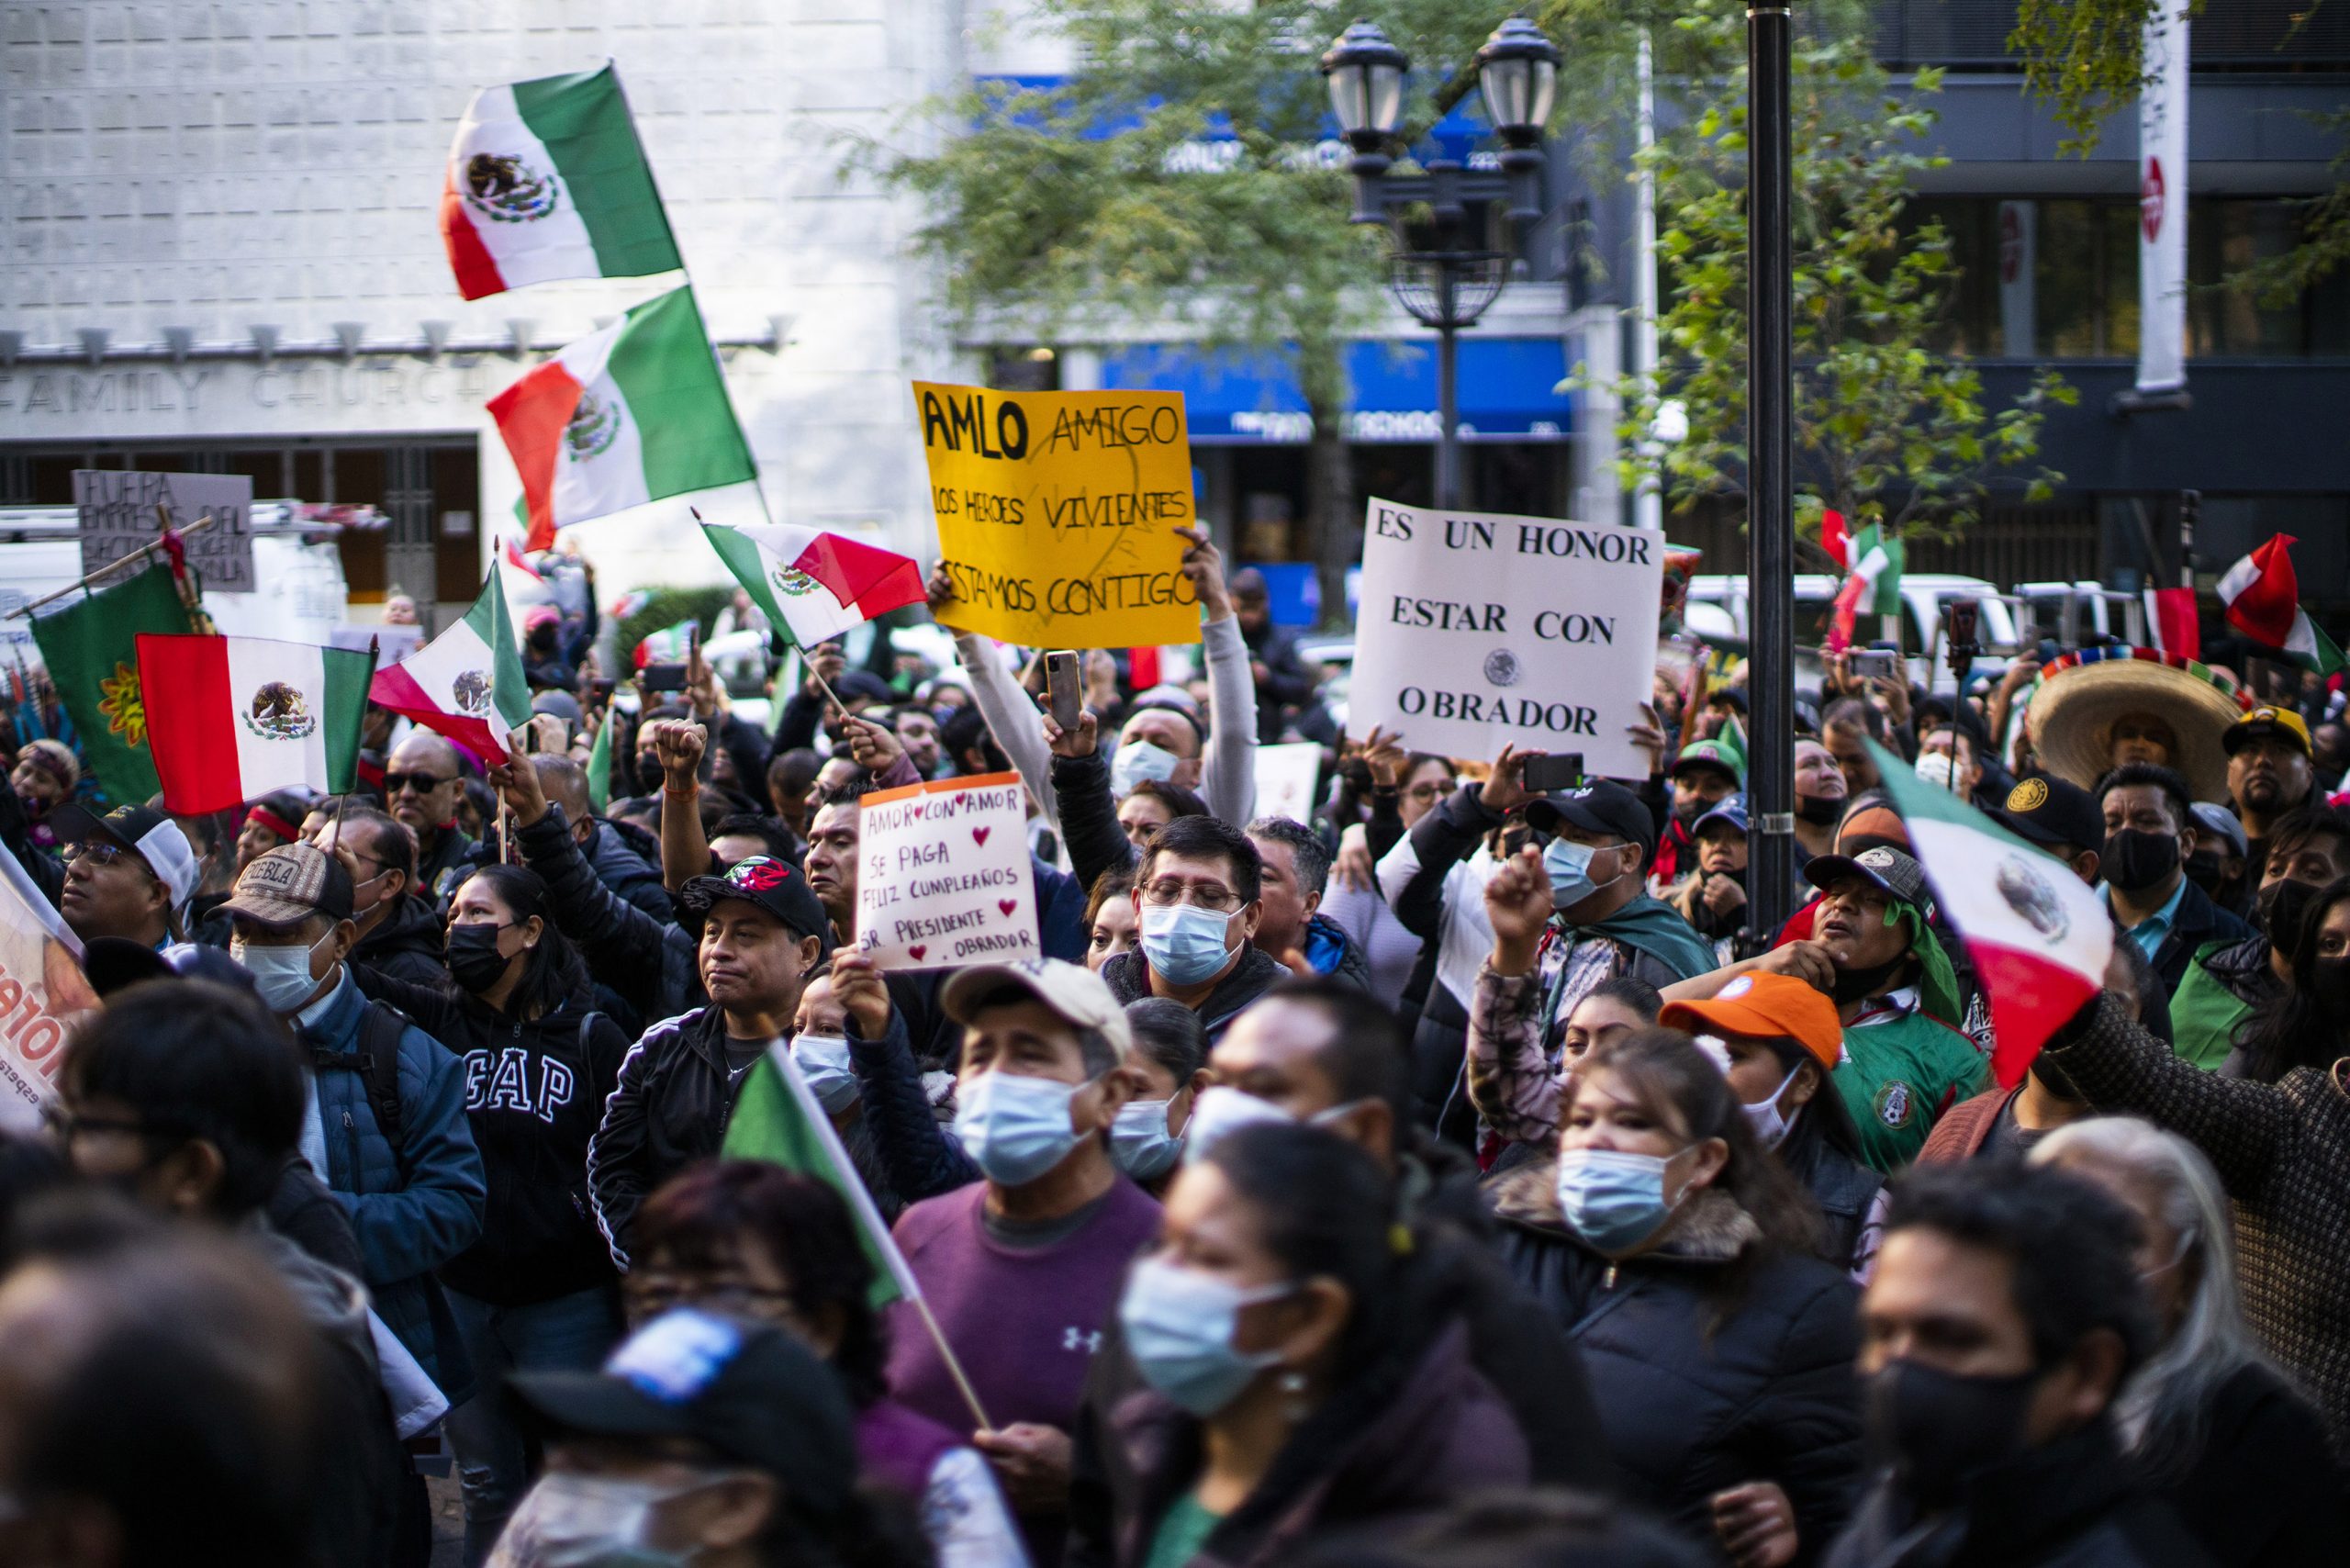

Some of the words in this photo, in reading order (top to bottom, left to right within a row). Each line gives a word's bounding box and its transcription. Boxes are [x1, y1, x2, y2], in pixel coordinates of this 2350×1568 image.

[924, 391, 1028, 460] AMLO
[1050, 405, 1179, 454] AMIGO
[933, 486, 958, 514] LOS
[966, 490, 1024, 525] HEROES
[1044, 491, 1187, 529] VIVIENTES
[1376, 508, 1413, 541] ES
[1445, 520, 1495, 549] UN
[1517, 524, 1651, 566] HONOR
[1047, 572, 1196, 615] CONTIGO
[1391, 595, 1506, 633] ESTAR
[1534, 610, 1616, 644] CON
[1398, 687, 1597, 735] OBRADOR
[868, 803, 912, 837] AMOR
[924, 800, 956, 821] CON
[966, 789, 1018, 813] AMOR
[243, 861, 294, 885] PUEBLA
[870, 856, 886, 879] SE
[899, 842, 949, 871] PAGA
[863, 886, 901, 913] FELIZ
[910, 867, 1018, 899] CUMPLEAÑOS
[895, 909, 985, 943] PRESIDENTE
[463, 1047, 575, 1123] GAP
